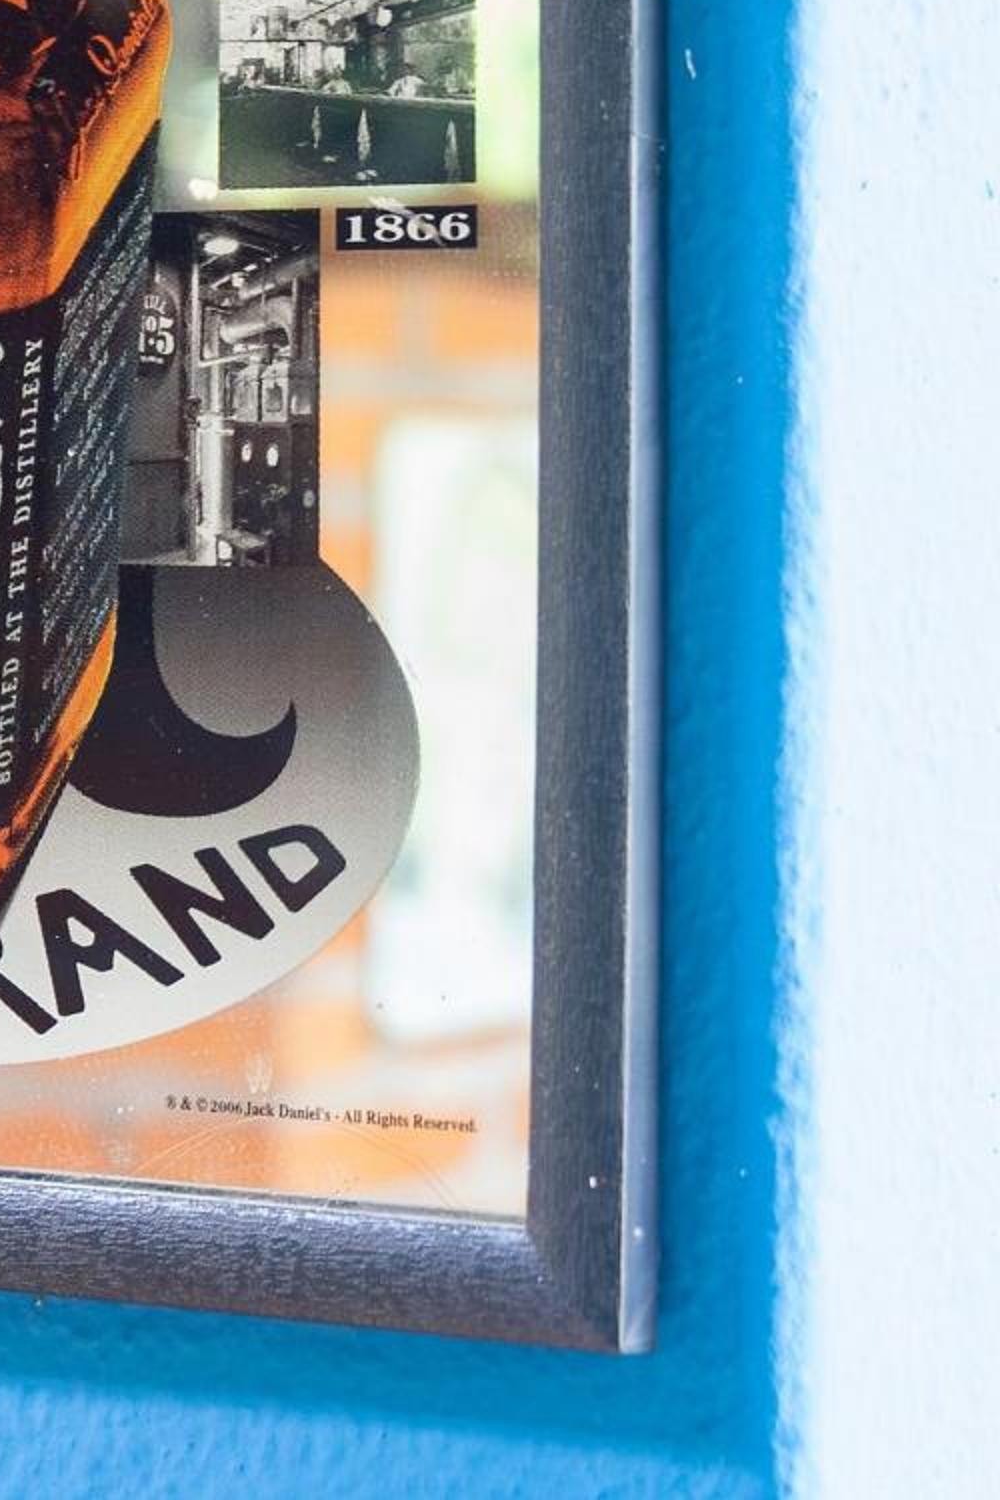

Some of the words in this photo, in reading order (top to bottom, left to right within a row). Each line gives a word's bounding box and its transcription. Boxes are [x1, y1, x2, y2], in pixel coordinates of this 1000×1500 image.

[345, 211, 471, 244] 1866
[13, 337, 44, 527] DISTILLERY
[7, 537, 31, 597] THE
[4, 612, 23, 643] AT
[343, 1109, 363, 1123] All
[366, 1111, 409, 1128] Rights
